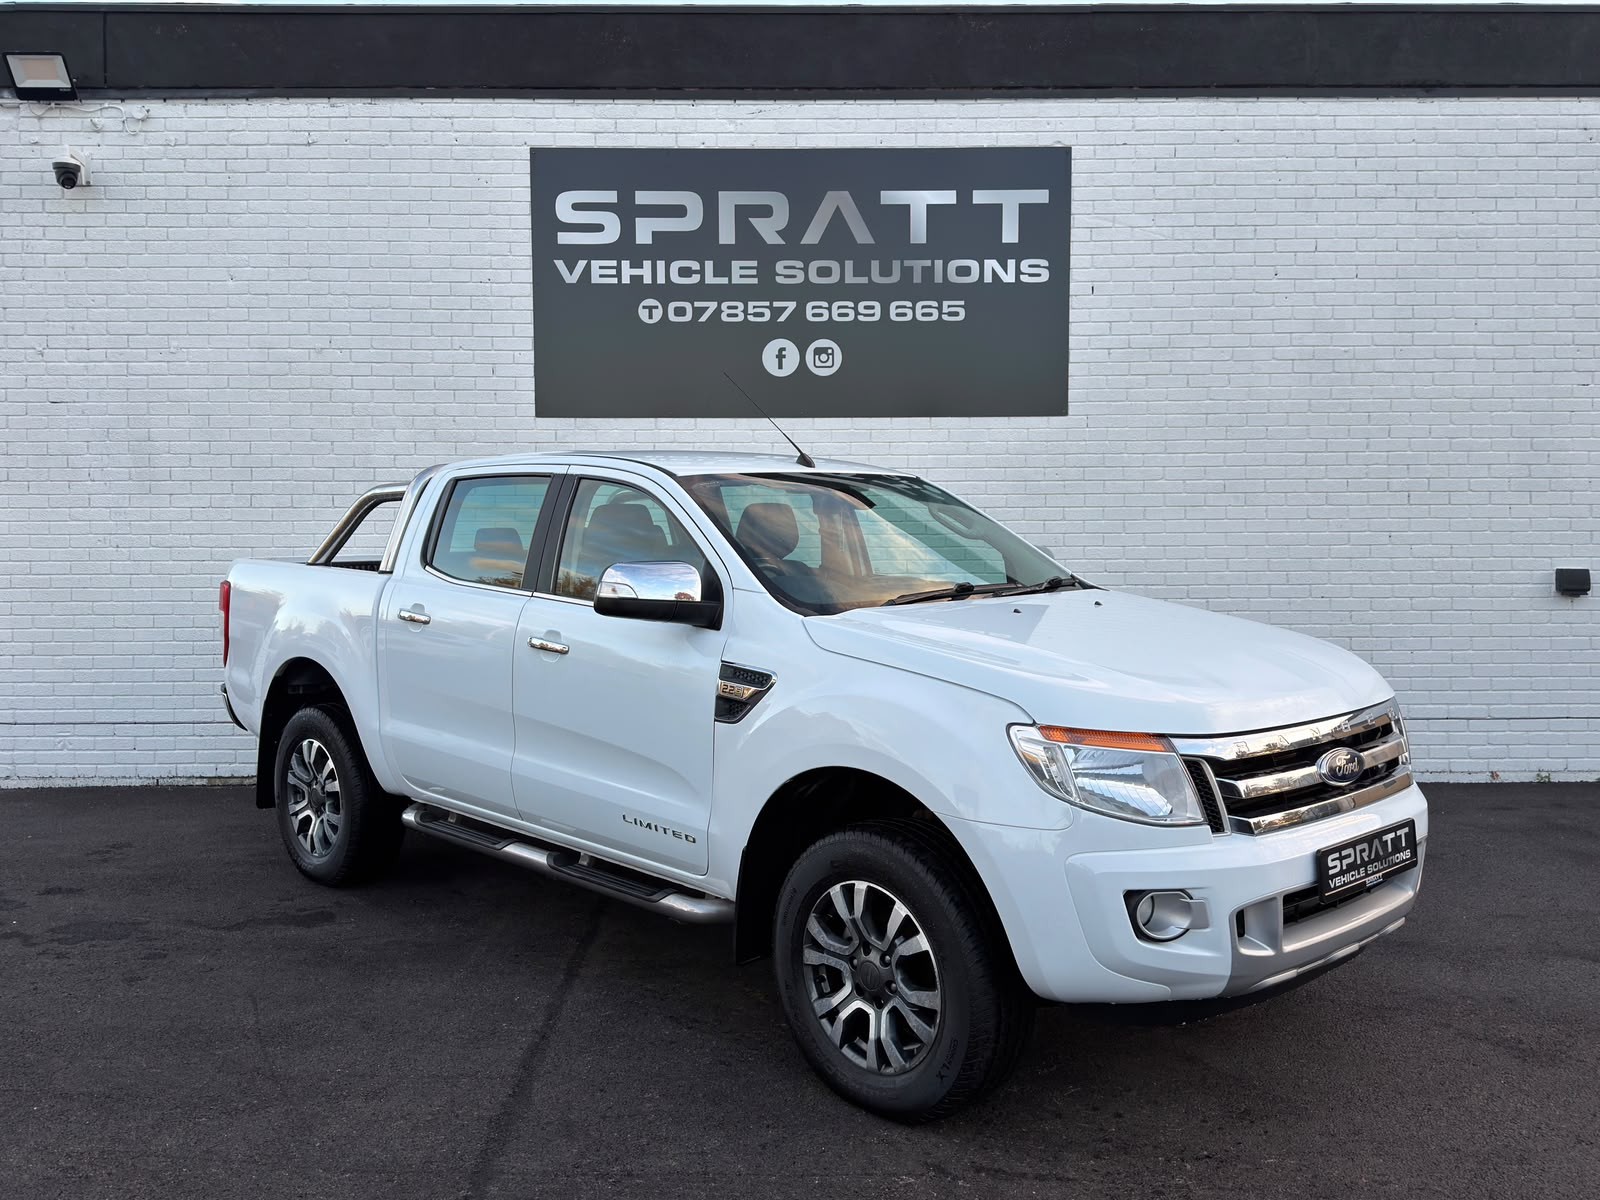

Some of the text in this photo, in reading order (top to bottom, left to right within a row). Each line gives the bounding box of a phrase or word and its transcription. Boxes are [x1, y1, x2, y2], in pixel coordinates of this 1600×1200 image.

[554, 189, 1050, 245] SPRATT
[553, 258, 1050, 285] VEHICLE SOLUTIONS
[667, 301, 797, 323] 07857
[804, 301, 881, 323] 669
[888, 300, 966, 322] 665
[1335, 753, 1360, 777] Ford
[622, 813, 697, 844] LIMITED
[1327, 826, 1409, 876] SPRATT
[1328, 849, 1411, 889] VEHICLE SOLUTIONS
